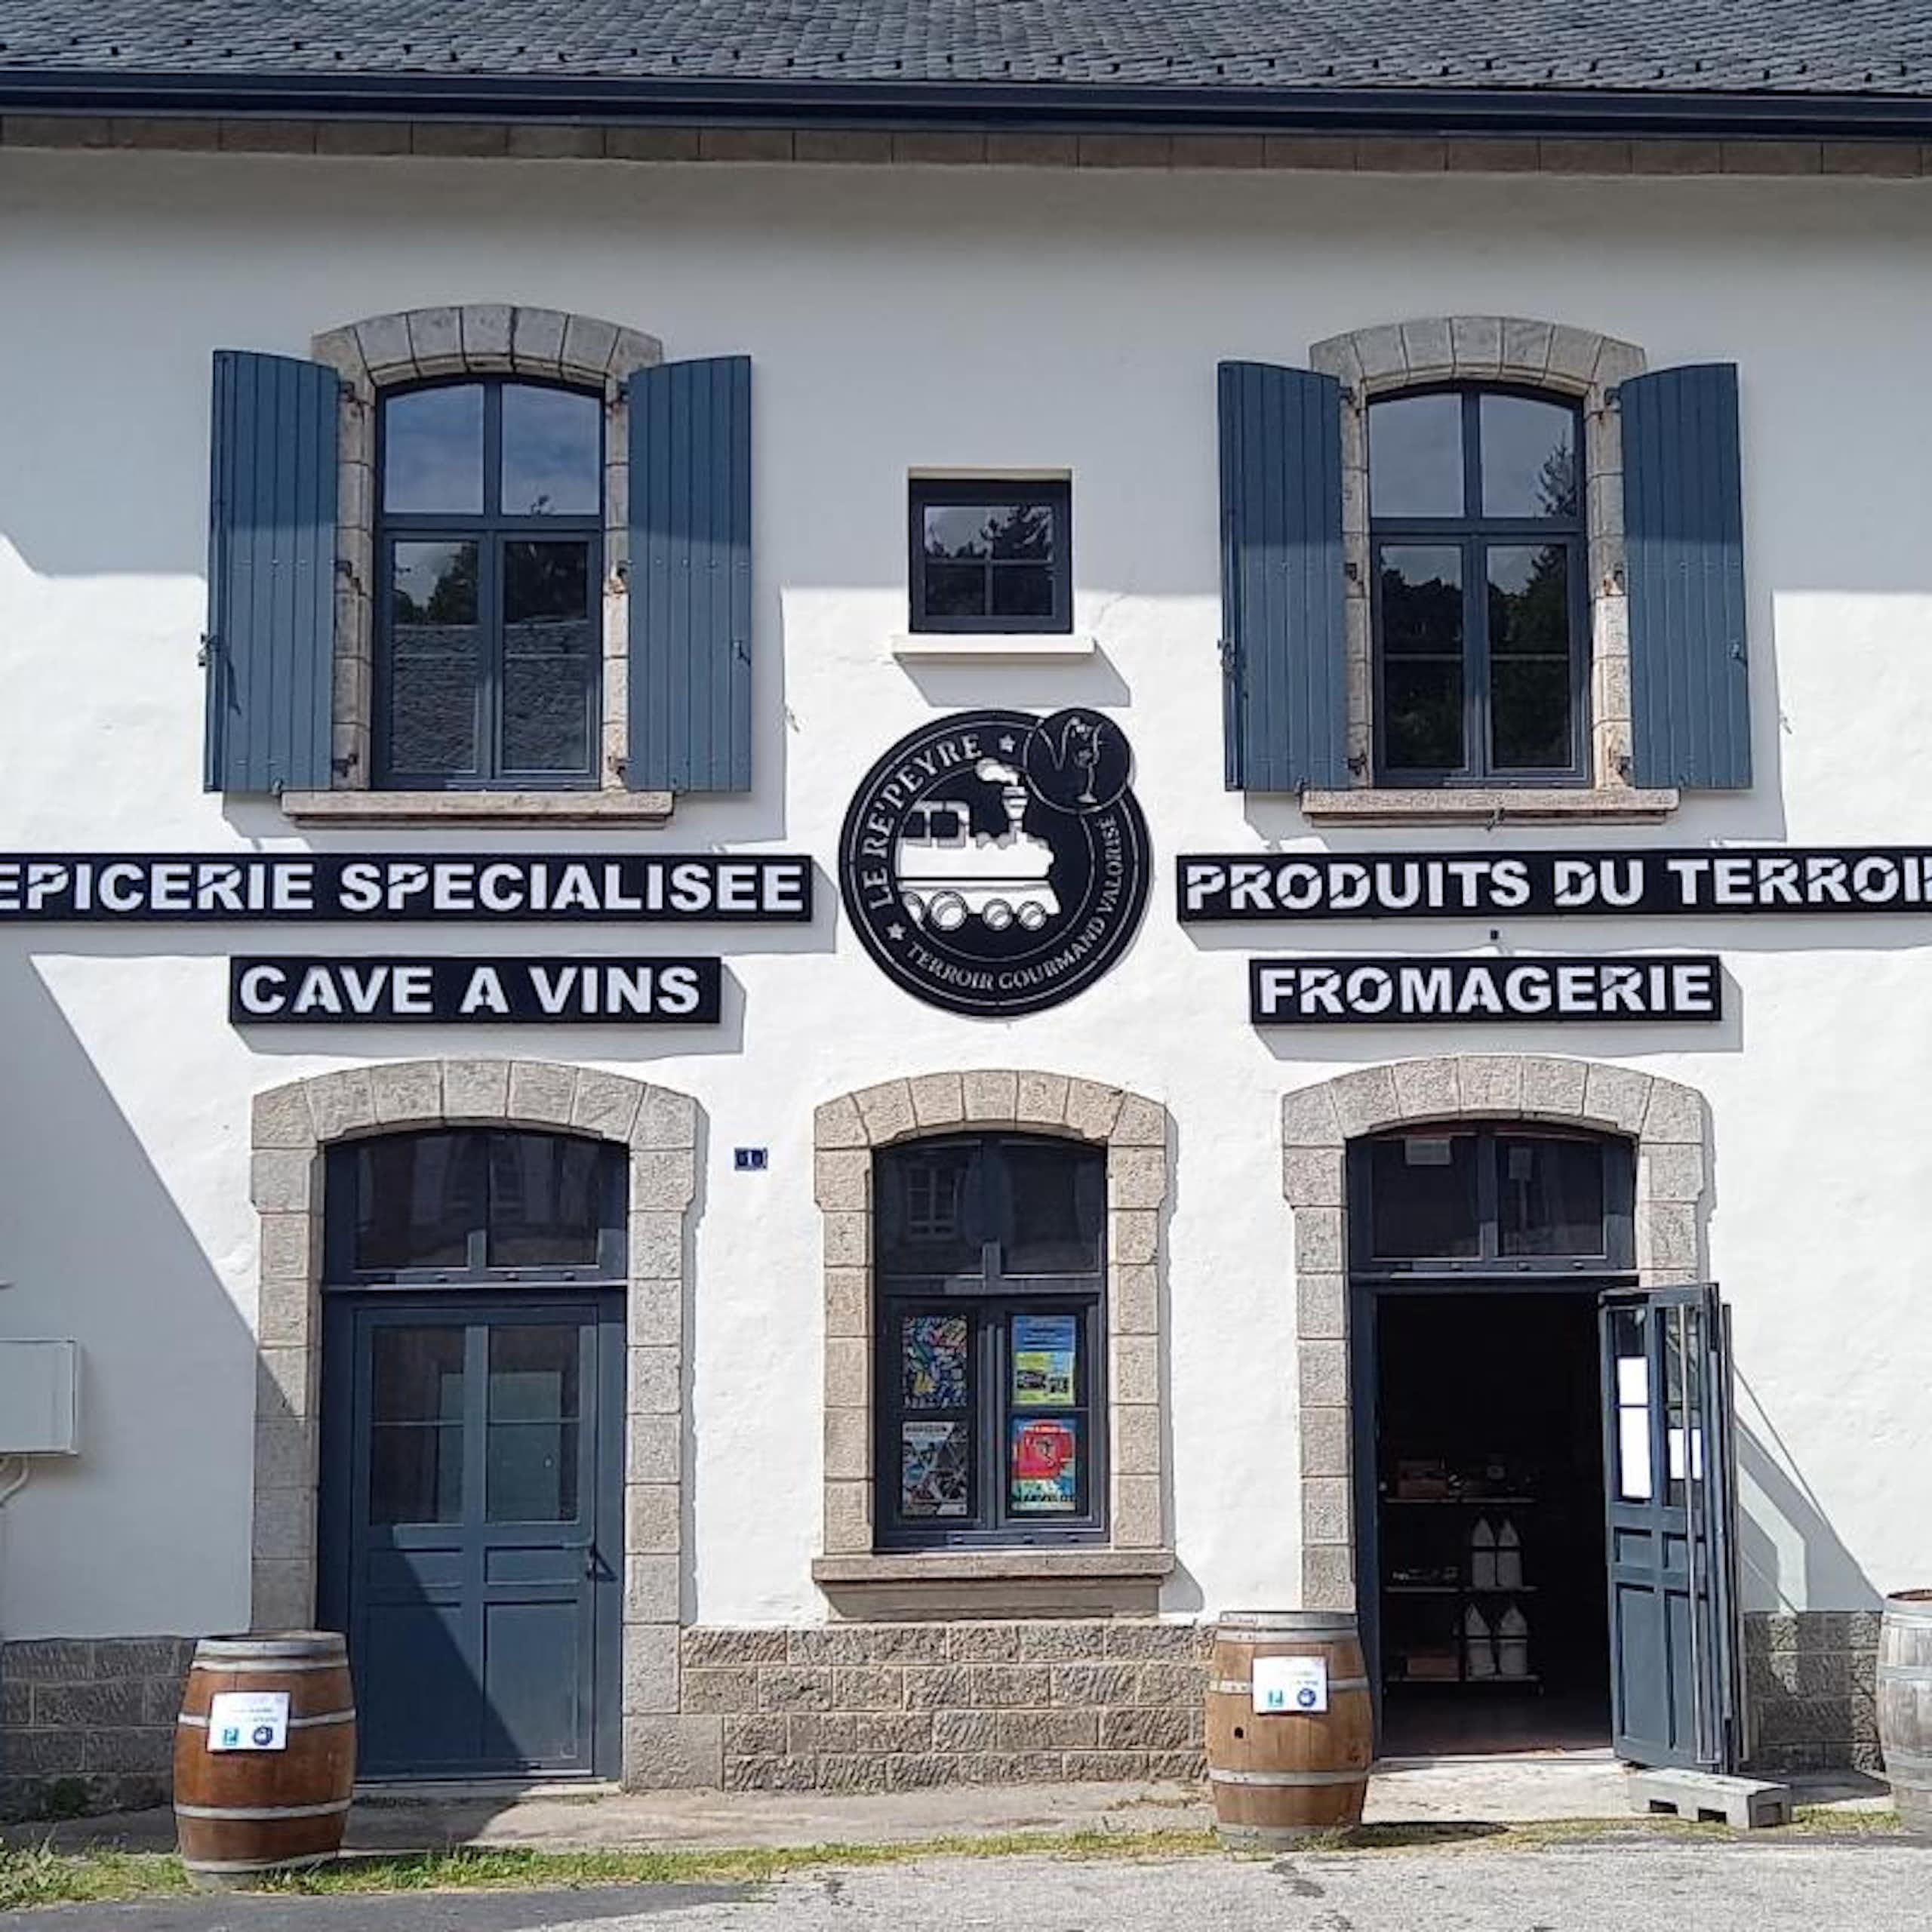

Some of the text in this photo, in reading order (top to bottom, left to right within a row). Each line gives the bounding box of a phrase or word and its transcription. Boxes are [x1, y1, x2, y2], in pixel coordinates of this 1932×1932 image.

[338, 863, 804, 912] SPECIALISEE
[861, 867, 894, 909] LE
[1186, 856, 1932, 910] PRODUITS DU TERROI
[906, 941, 995, 992] TERROIR
[998, 916, 1106, 989] GOURMAND
[239, 965, 700, 1015] CAVE A VINS
[1259, 965, 1714, 1014] FROMAGERIE
